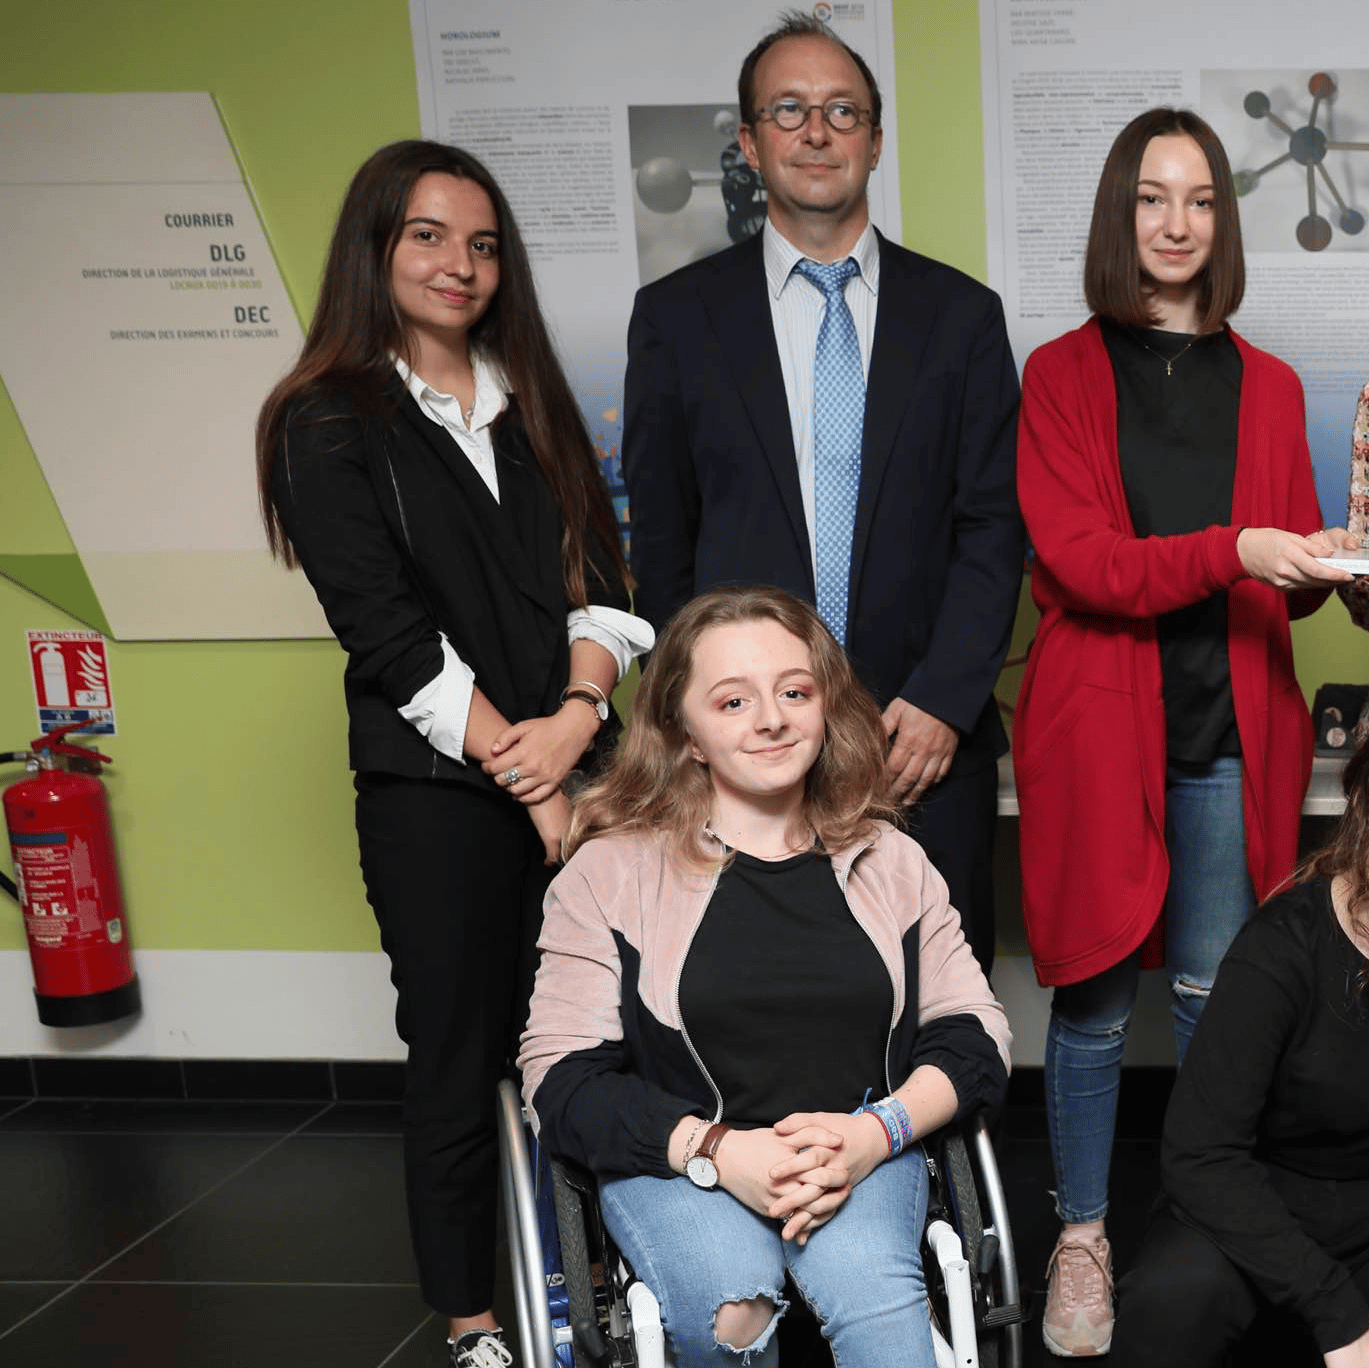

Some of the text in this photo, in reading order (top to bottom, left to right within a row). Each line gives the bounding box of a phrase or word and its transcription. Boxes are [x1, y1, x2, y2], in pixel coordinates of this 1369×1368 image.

[165, 213, 234, 228] COURRIER
[210, 243, 246, 262] DLG
[82, 268, 129, 278] DIRECTION
[131, 268, 141, 278] DE
[144, 268, 156, 278] LA
[158, 267, 207, 278] LOGISTIQUE
[234, 306, 271, 323] DEC
[110, 328, 278, 340] DIRECTION DES EXAMENS ET CONCOURS
[28, 631, 103, 640] EXTINCTEUR
